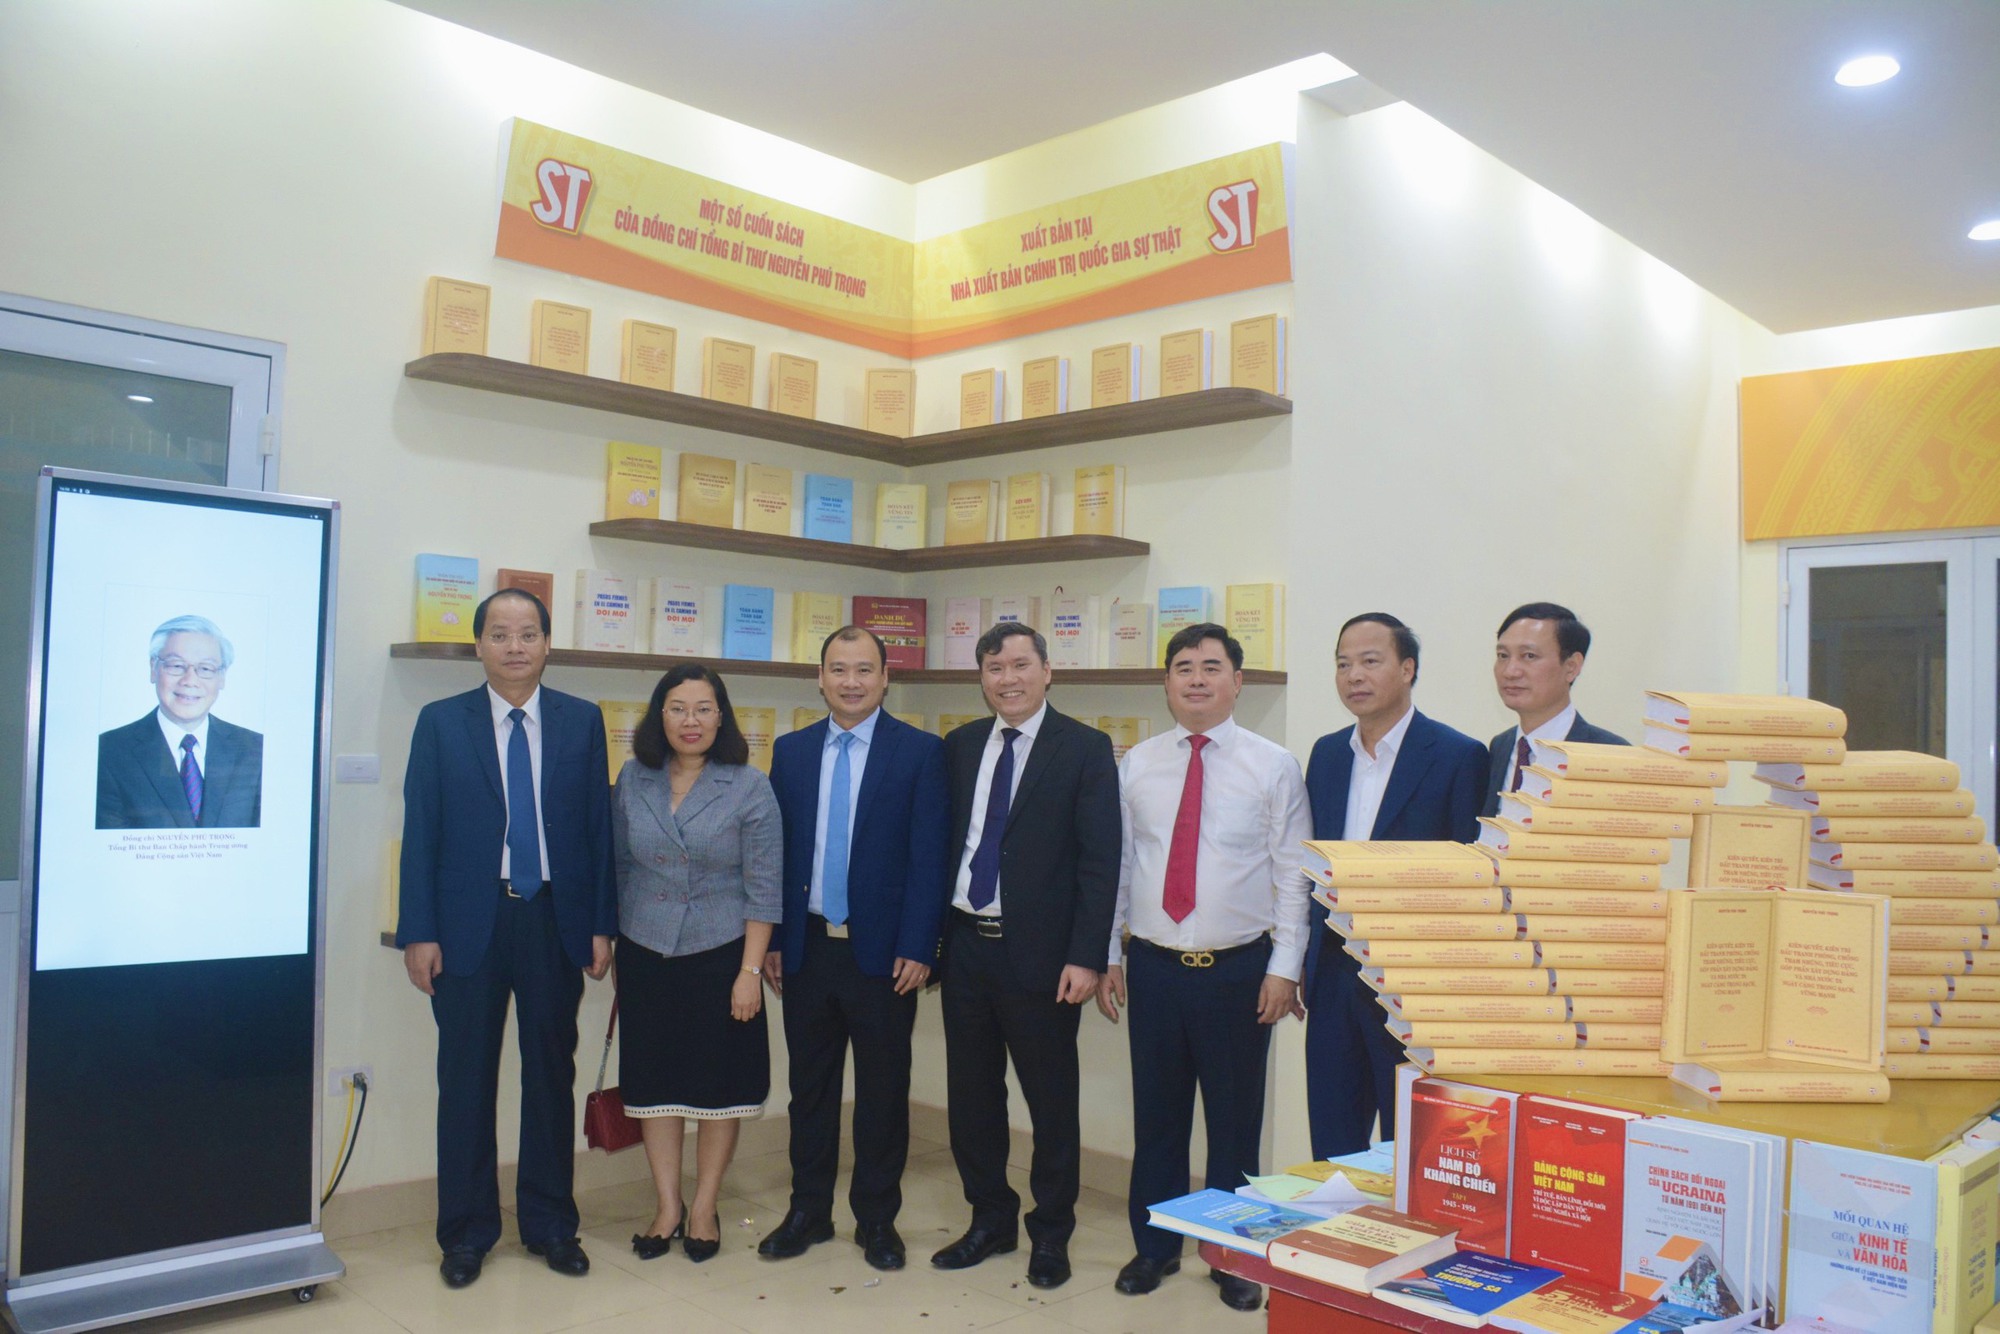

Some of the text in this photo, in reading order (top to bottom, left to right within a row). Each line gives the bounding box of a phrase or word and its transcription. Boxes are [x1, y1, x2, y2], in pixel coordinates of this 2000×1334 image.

[532, 160, 590, 230] ST
[699, 198, 805, 248] MỘT SỐ CUỐN SÁCH
[1208, 181, 1257, 250] ST
[1021, 216, 1093, 253] XUẤT BẢN TẠI
[614, 205, 867, 298] CỦA ĐỒNG CHÍ TỔNG BÍ THƯ NGUYỄN PHÚ TRỌNG
[950, 225, 1182, 302] NHÀ XUẤT BẢN CHÍNH TRỊ QUỐC GIA SỰ THẬT
[1440, 1144, 1465, 1157] LỊCH
[1424, 1166, 1496, 1195] KHÁNG CHIẾN
[1438, 1156, 1481, 1178] NAM BỘ
[1534, 1160, 1606, 1187] ĐẢNG CỘNG SẢN
[1648, 1165, 1726, 1192] CHÍNH SÁCH ĐỐI NGOẠI
[1533, 1174, 1575, 1194] VIỆT NAM
[1648, 1176, 1726, 1205] CỦA UCRAINA
[1442, 1198, 1457, 1208] 1945
[1461, 1203, 1477, 1213] 1954
[1700, 1201, 1712, 1213] ĐẾN
[1713, 1206, 1726, 1216] NAY
[1833, 1209, 1910, 1237] MỐI QUAN HỆ
[1858, 1231, 1889, 1251] KINH
[1893, 1237, 1908, 1256] TẾ
[1853, 1246, 1878, 1265] VĂN
[1881, 1253, 1908, 1273] HÓA
[1483, 1284, 1502, 1293] SA
